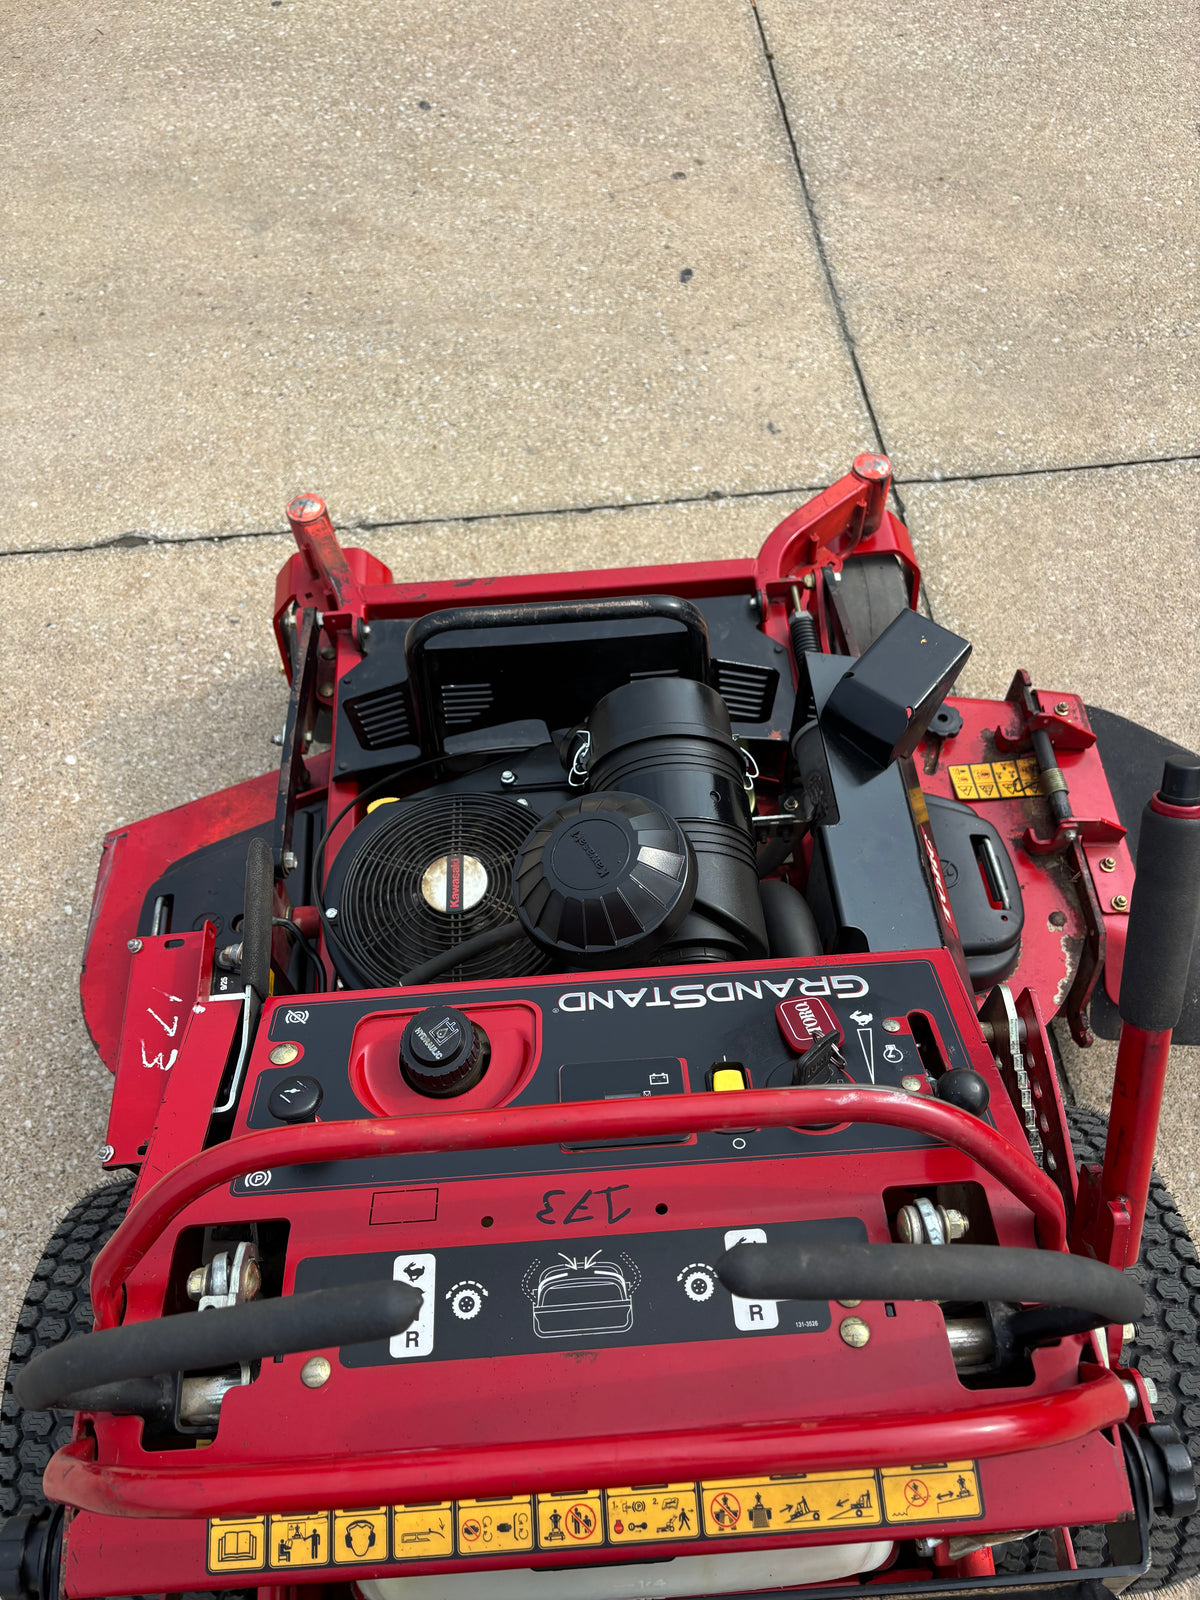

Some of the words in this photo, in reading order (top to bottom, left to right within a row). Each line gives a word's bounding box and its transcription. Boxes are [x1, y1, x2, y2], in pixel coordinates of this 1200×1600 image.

[571, 831, 610, 879] Kawasaki
[449, 858, 460, 908] Kawasaki
[795, 1001, 822, 1036] TORO
[414, 1026, 443, 1060] HYDRAULIC
[535, 1184, 631, 1226] 173
[748, 1304, 764, 1321] R
[406, 1331, 419, 1348] R
